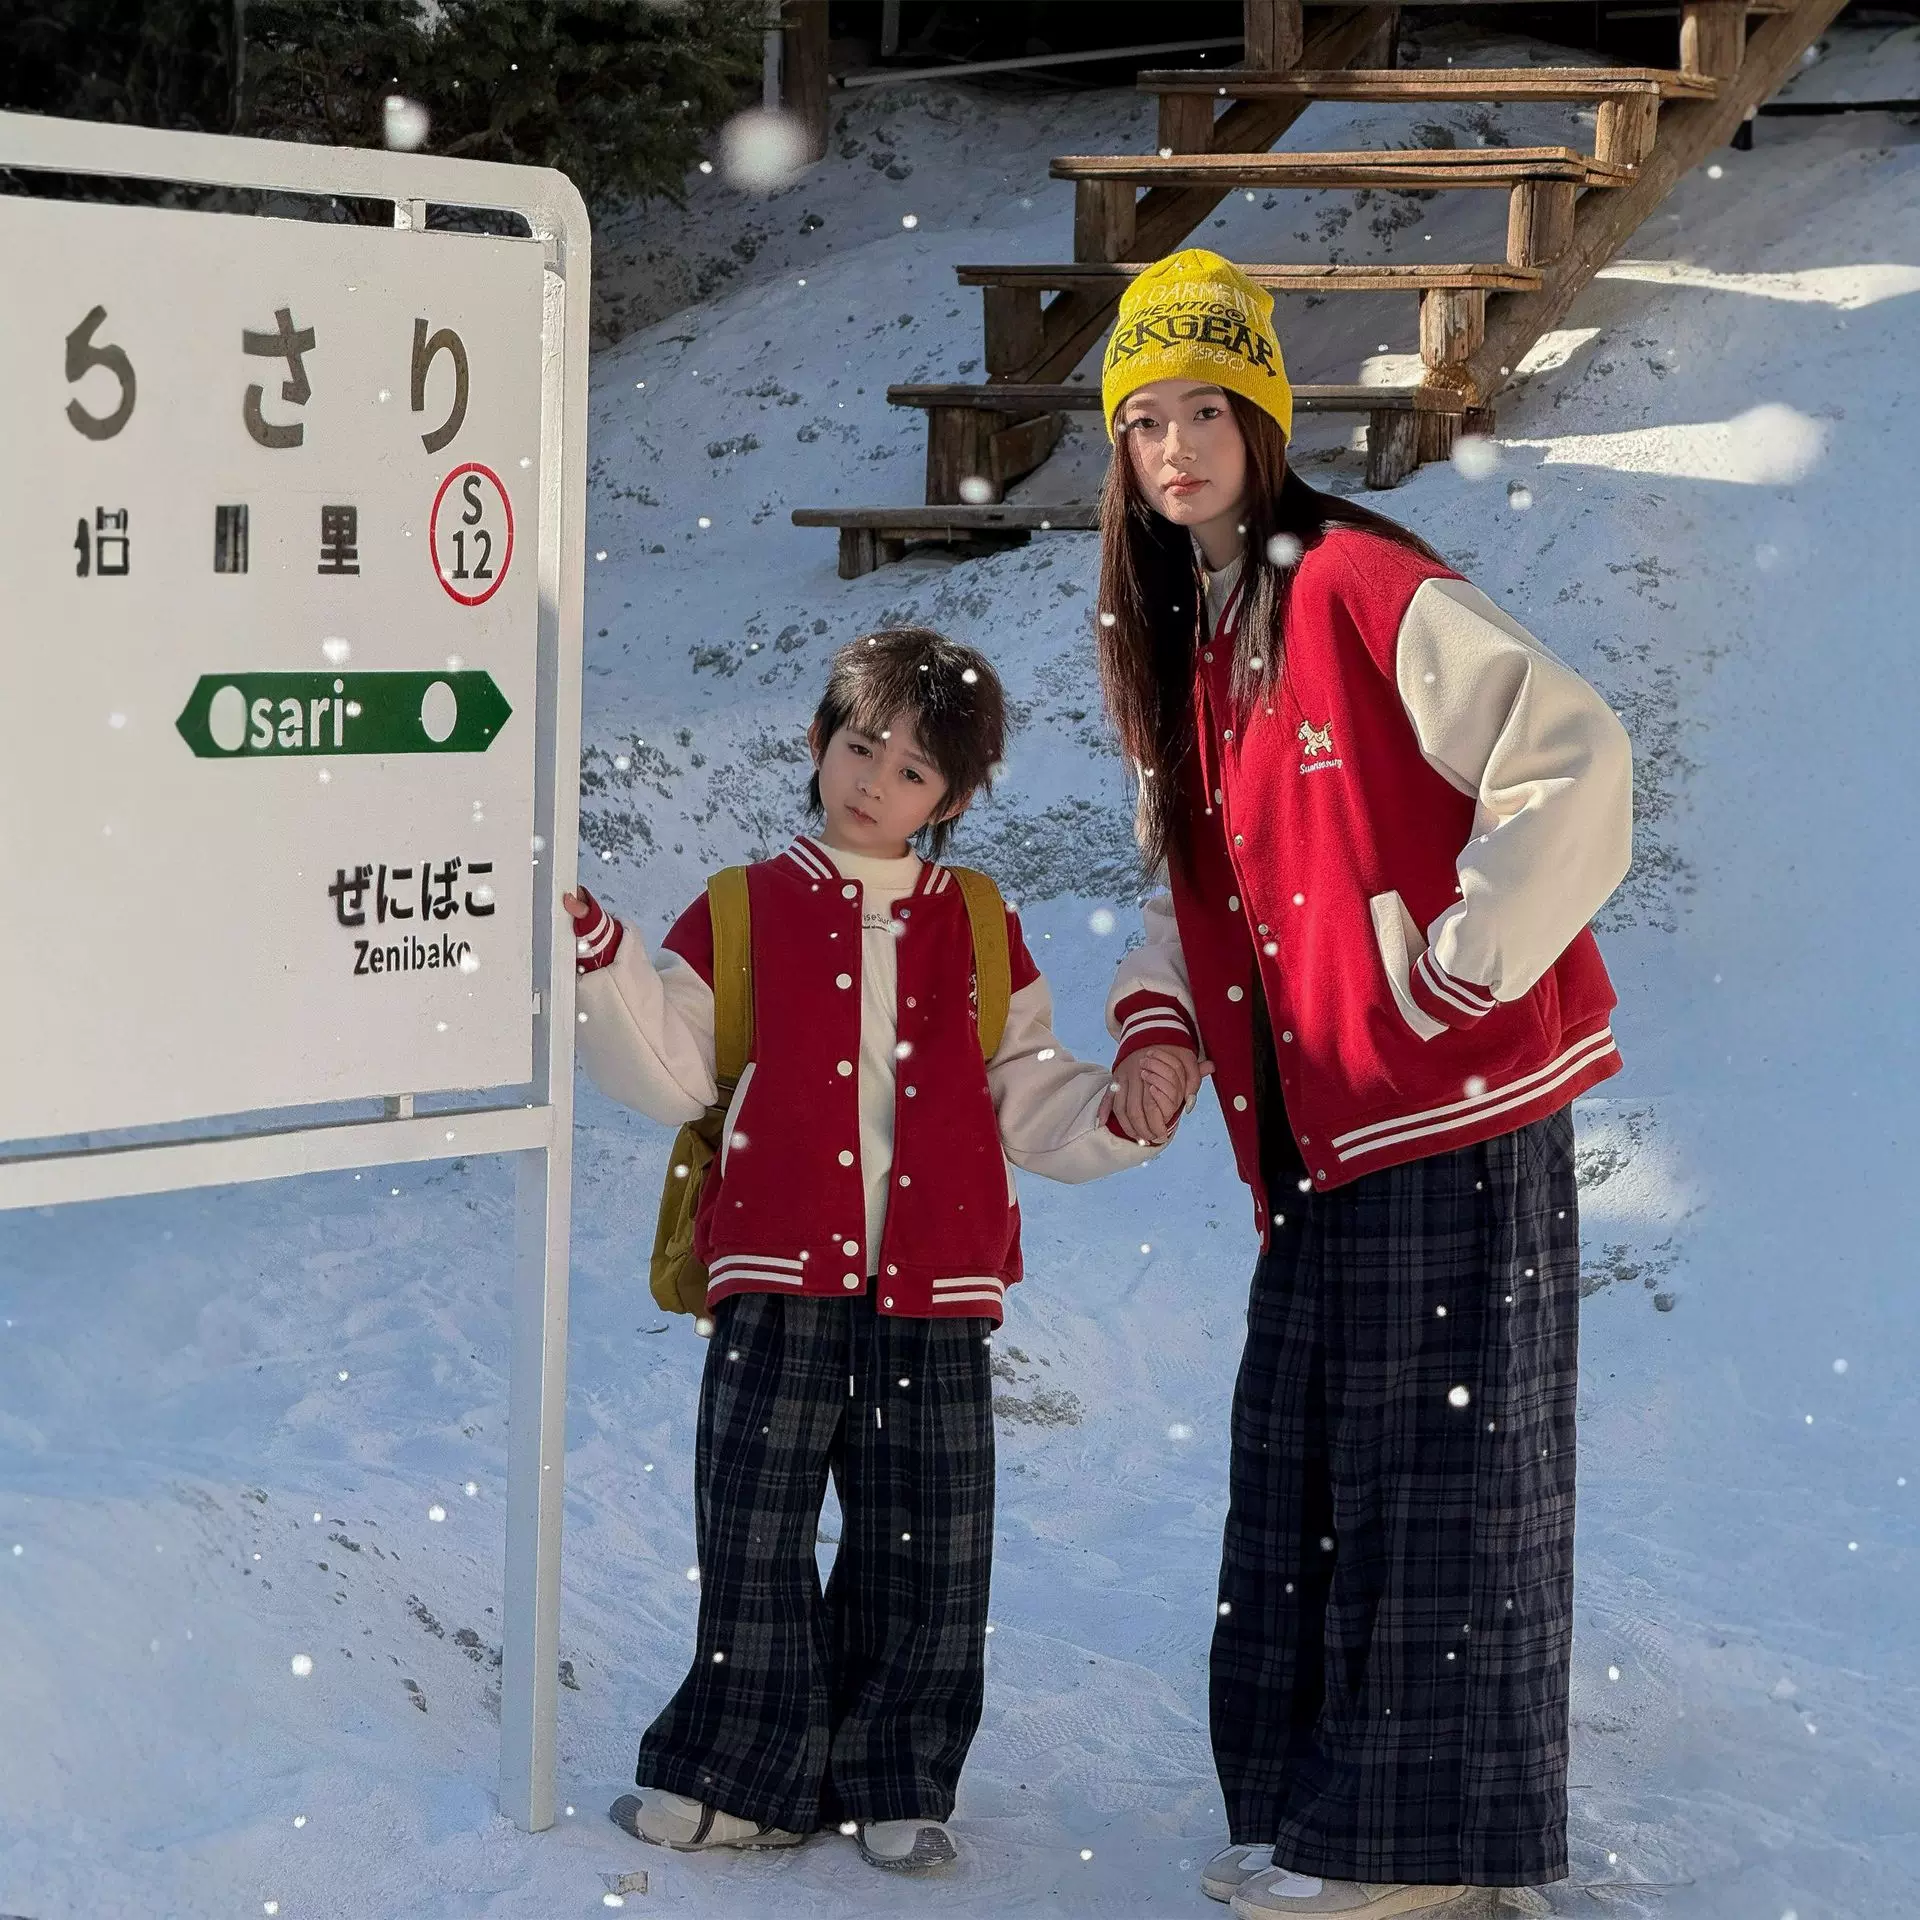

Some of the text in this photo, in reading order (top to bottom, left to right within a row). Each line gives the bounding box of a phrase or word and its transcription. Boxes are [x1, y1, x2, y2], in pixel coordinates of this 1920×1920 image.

[461, 474, 483, 526] S
[451, 529, 493, 580] 12
[328, 856, 495, 927] ぜにばこ
